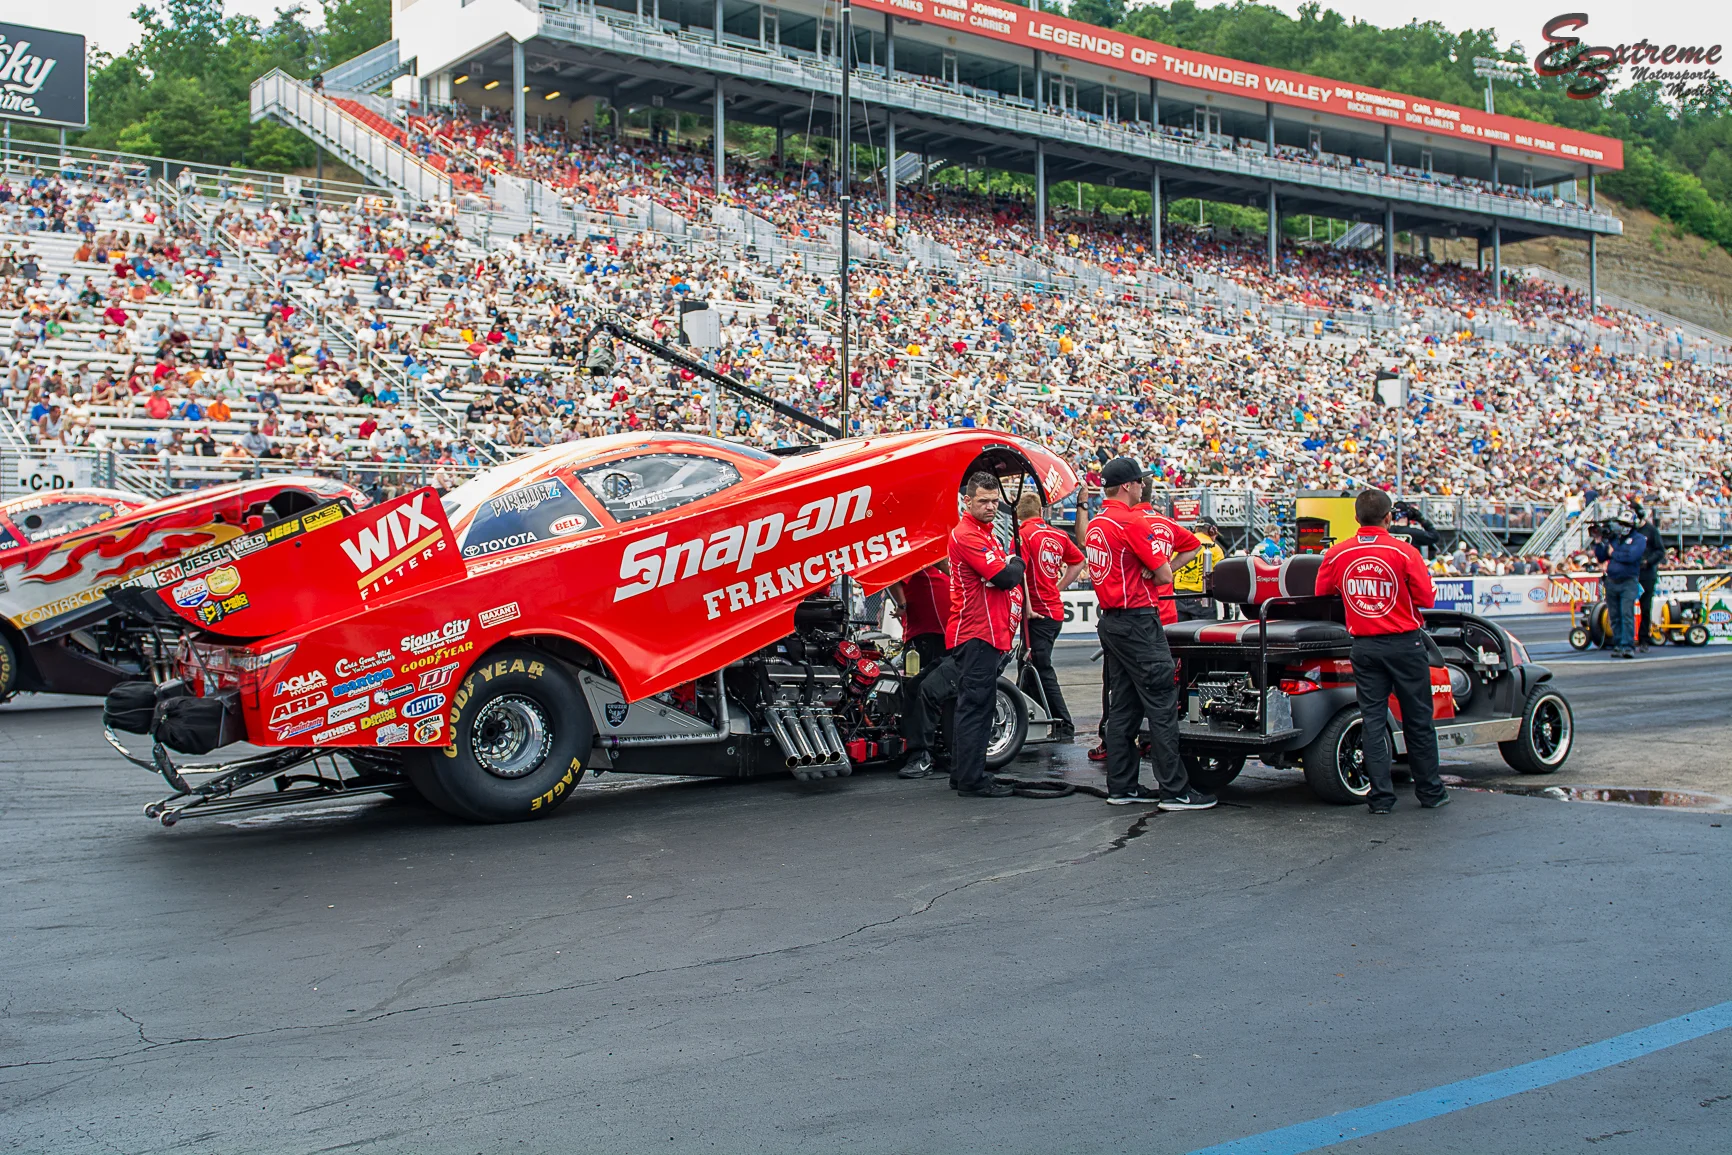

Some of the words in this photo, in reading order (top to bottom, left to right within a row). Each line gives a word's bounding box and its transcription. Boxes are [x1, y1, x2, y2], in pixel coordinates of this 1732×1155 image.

[932, 6, 965, 22] LARRY
[968, 15, 1009, 34] CARRIER
[969, 2, 1016, 22] JOHNSON
[1027, 21, 1124, 59] LEGENDS
[1130, 47, 1157, 66] OF
[1161, 55, 1258, 89] THUNDER
[1264, 77, 1331, 102] VALLEY
[628, 496, 647, 510] ALAN
[646, 493, 667, 505] BALES
[265, 519, 299, 542] JEGS
[339, 492, 438, 574] WIX
[554, 518, 582, 531] BELL
[233, 535, 264, 553] WELD
[479, 532, 538, 553] TOYOTA
[613, 485, 873, 603] Snap-on
[183, 549, 228, 573] JESEL
[359, 539, 446, 601] FILTERS
[1356, 563, 1384, 575] SNAP-ON
[156, 564, 183, 585] 3M
[703, 527, 912, 621] FRANCHISE
[179, 585, 204, 599] LUCAS
[1347, 578, 1377, 597] OWN
[1380, 581, 1393, 598] IT
[1548, 581, 1580, 604] LUCAS
[481, 605, 515, 621] MAXANT
[400, 630, 440, 653] Sioux
[442, 618, 470, 638] City
[413, 647, 432, 656] Truck
[432, 641, 446, 650] And
[445, 634, 466, 645] Trailer
[274, 670, 327, 697] AQUA
[290, 680, 328, 697] HYDRATE
[332, 668, 394, 697] manton
[271, 692, 326, 721] ARP
[401, 695, 443, 717] CLEVITE
[473, 695, 503, 730] RACING
[311, 722, 357, 743] MOTHERS
[530, 757, 581, 811] EAGLE
